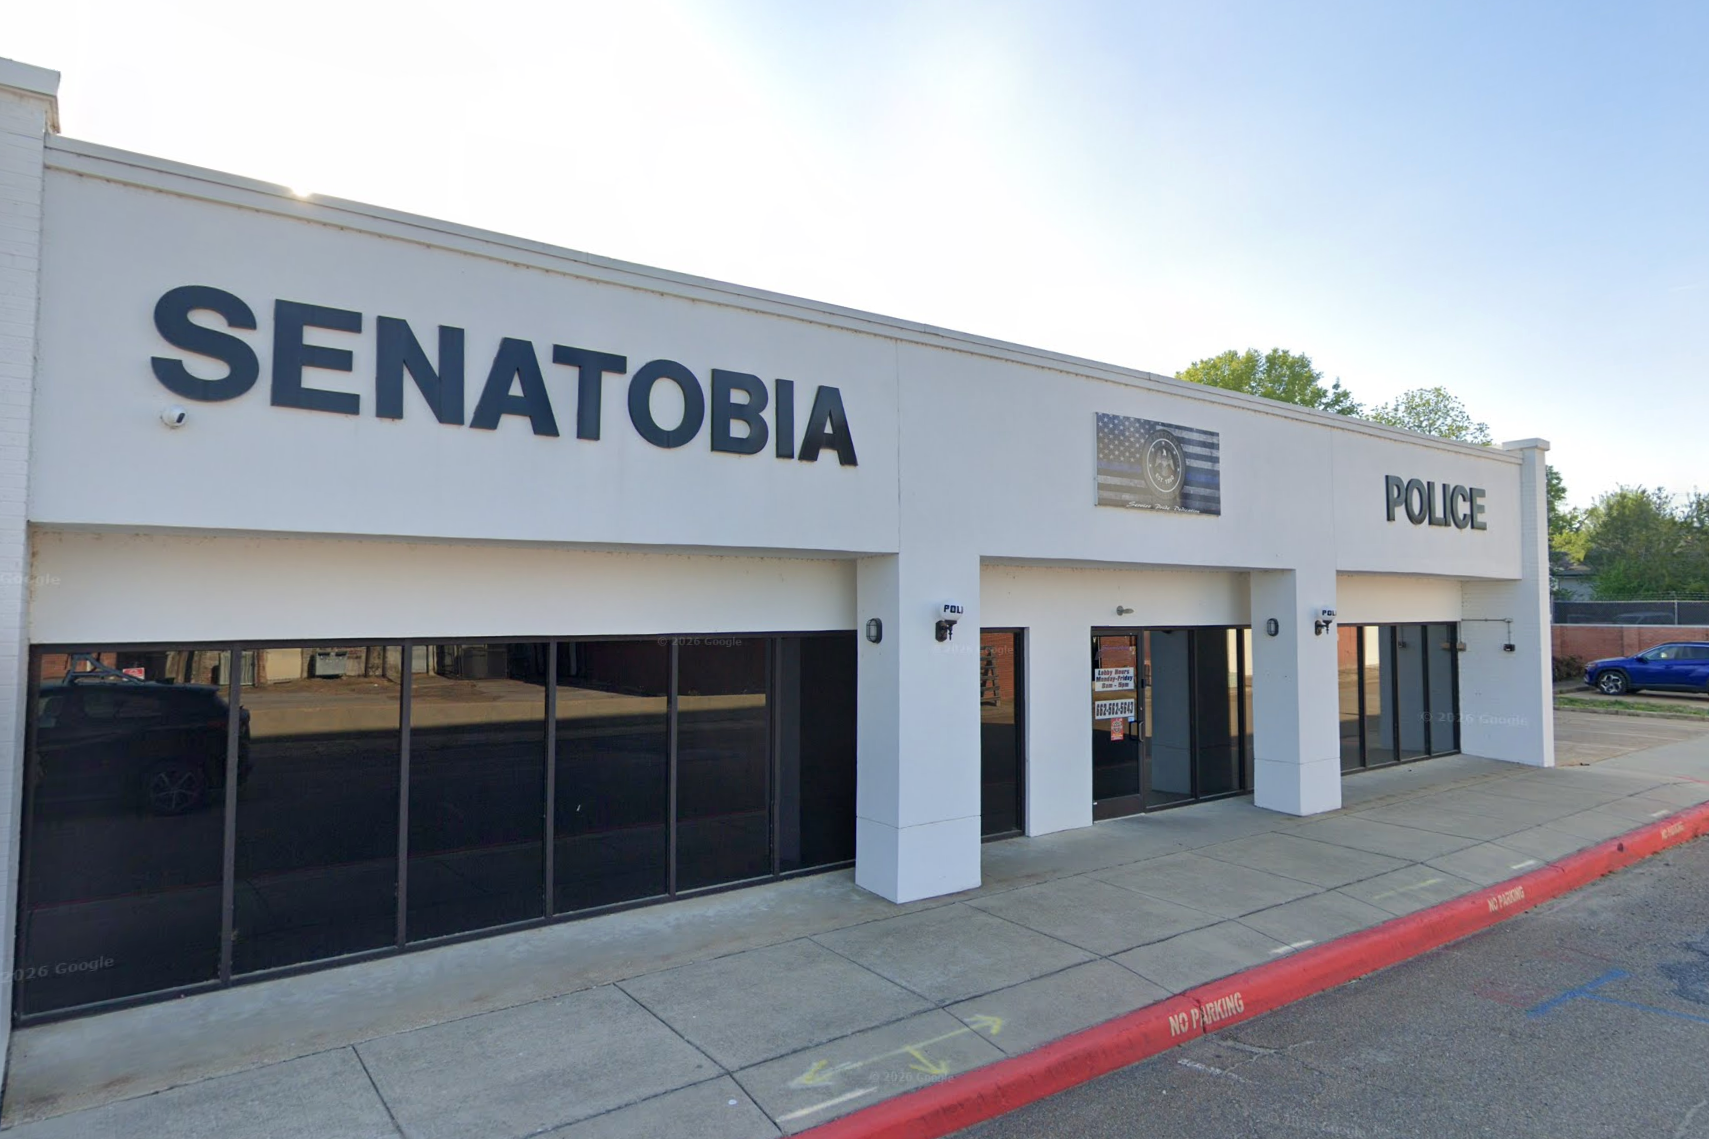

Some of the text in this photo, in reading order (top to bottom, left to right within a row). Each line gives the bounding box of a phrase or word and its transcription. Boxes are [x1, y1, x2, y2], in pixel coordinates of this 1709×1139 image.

[150, 284, 858, 467] SENATOBIA
[1385, 474, 1487, 531] POLICE
[1096, 701, 1134, 716] 662-562-5643
[1487, 886, 1524, 913] NO PARKING
[1168, 992, 1244, 1037] NO PARKING
